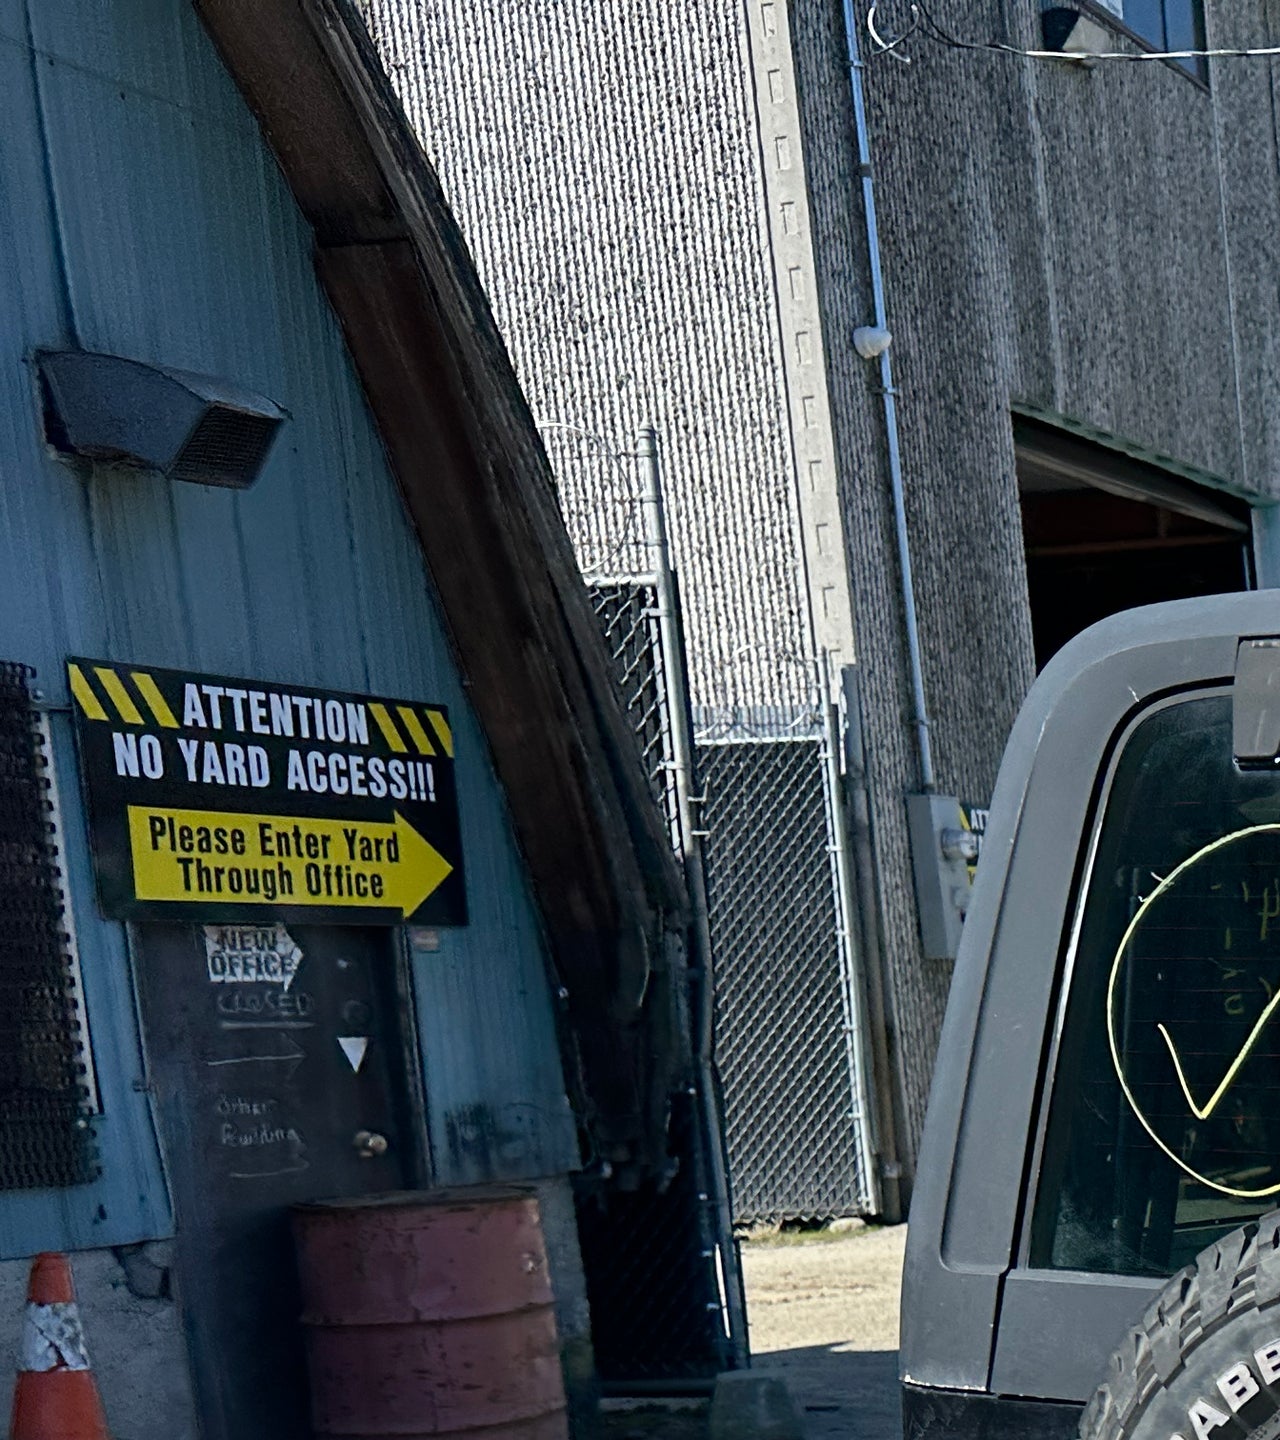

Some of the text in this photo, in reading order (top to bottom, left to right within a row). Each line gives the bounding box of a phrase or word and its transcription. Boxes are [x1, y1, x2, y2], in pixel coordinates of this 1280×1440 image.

[183, 682, 369, 746] ATTENTION
[112, 732, 436, 802] NO YARD ACCESS!!!
[150, 815, 400, 864] Please Enter Yard
[176, 857, 384, 900] Through Office
[217, 930, 277, 950] NEW
[210, 951, 298, 977] OFFICE
